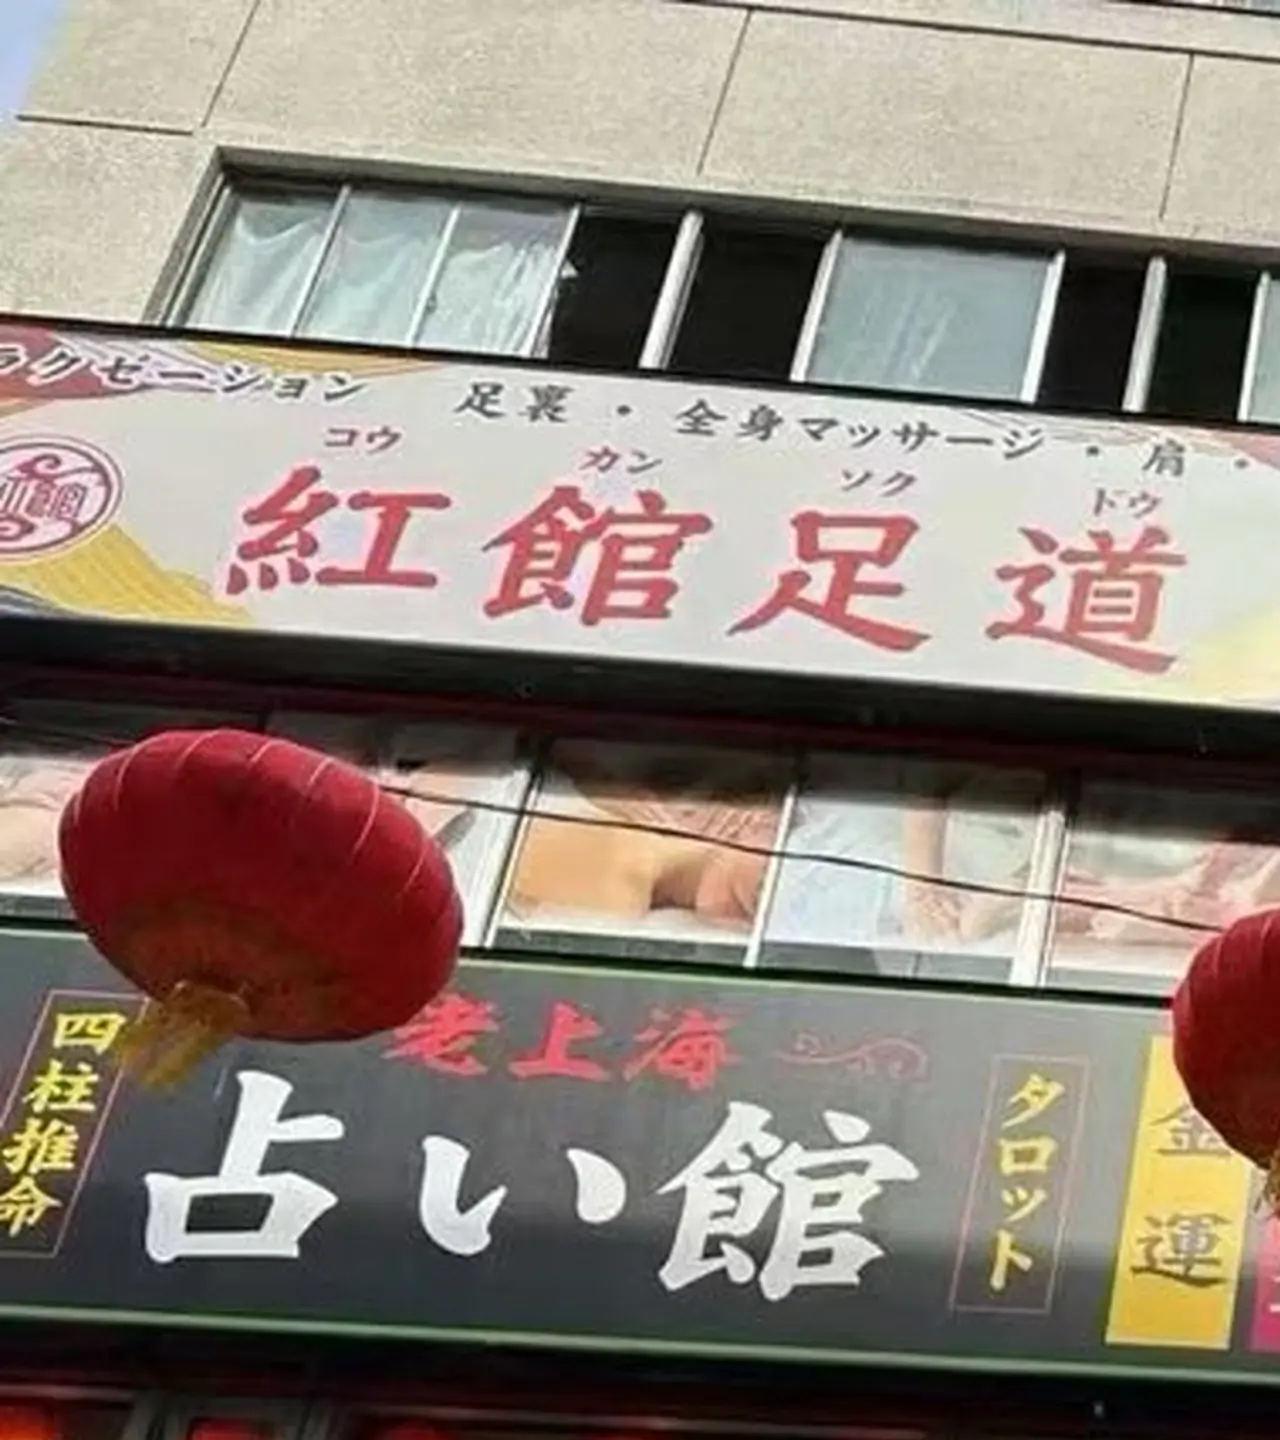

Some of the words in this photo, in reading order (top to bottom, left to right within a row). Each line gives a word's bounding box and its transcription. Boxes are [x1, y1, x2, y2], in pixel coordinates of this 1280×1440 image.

[227, 464, 1188, 676] 紅館足道
[325, 425, 402, 453] コウ
[578, 444, 663, 475] カン
[841, 467, 918, 498] ソク
[1091, 486, 1161, 521] ドウ
[0, 1012, 127, 1237] 四柱推命
[382, 996, 741, 1092] 老上海
[142, 1070, 920, 1302] 占い館
[987, 1072, 1066, 1292] タロット
